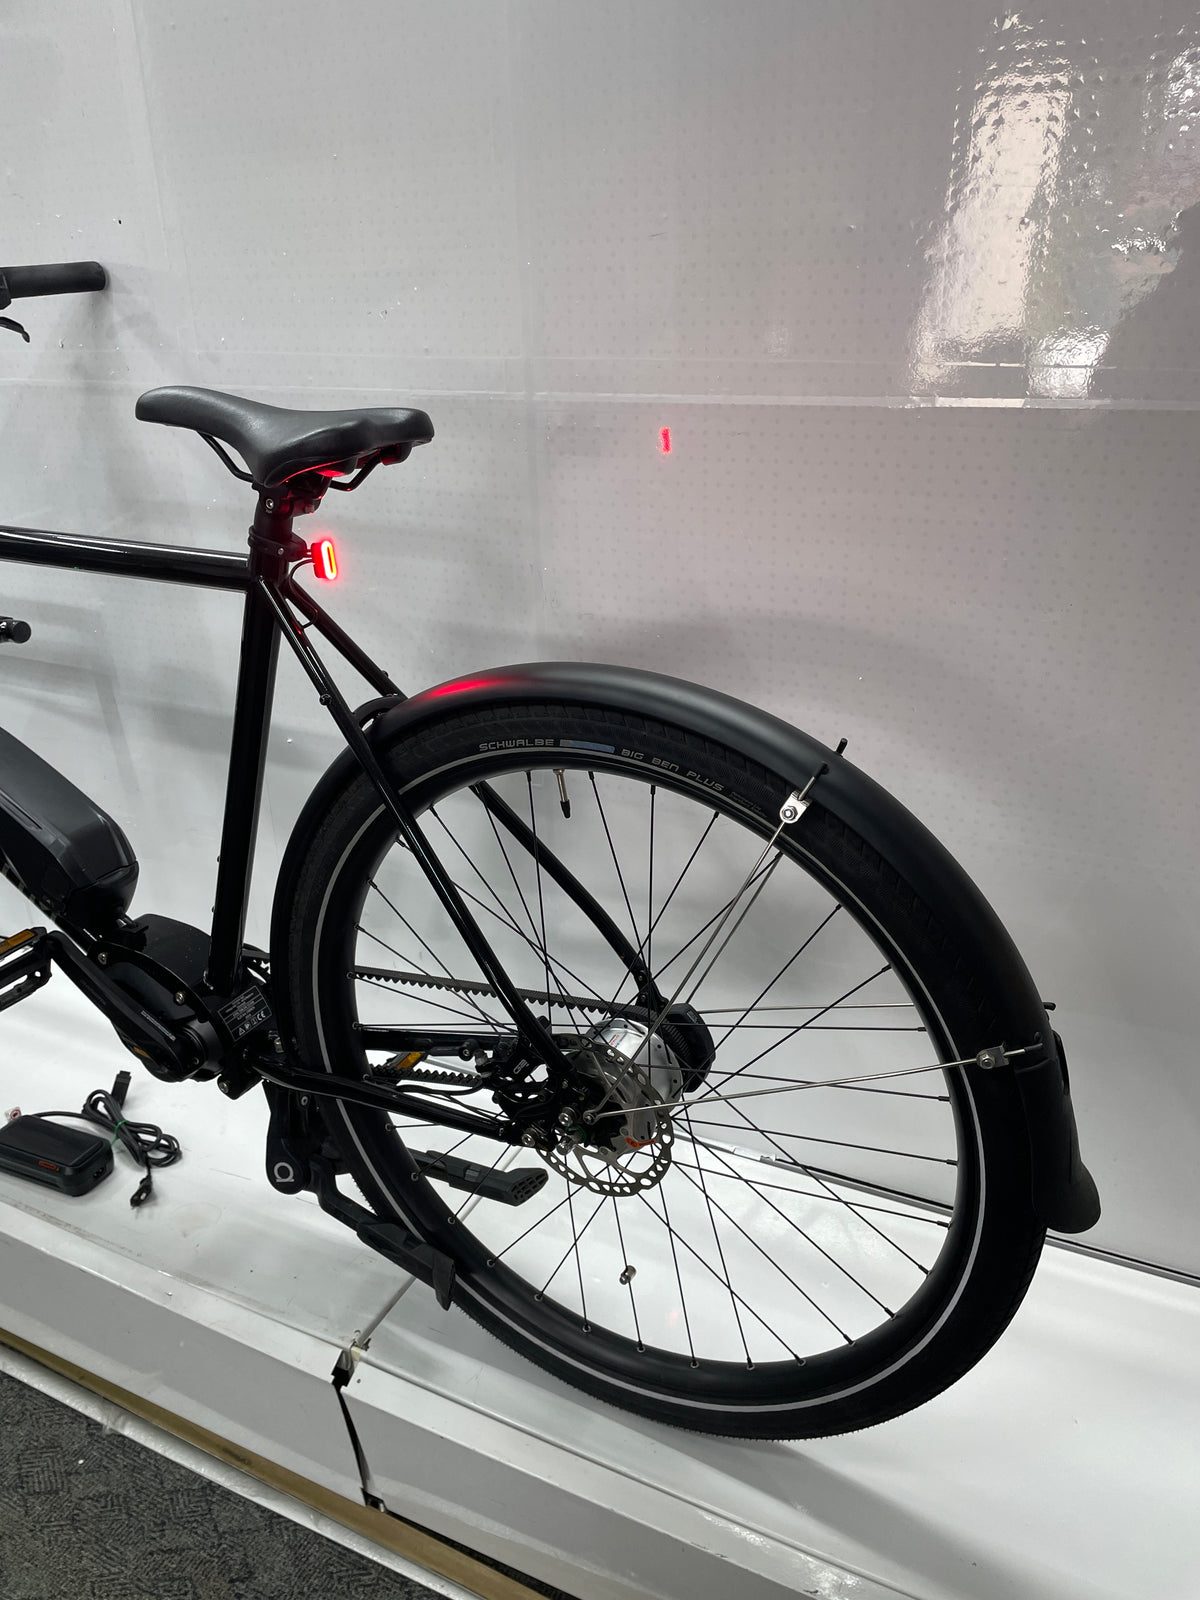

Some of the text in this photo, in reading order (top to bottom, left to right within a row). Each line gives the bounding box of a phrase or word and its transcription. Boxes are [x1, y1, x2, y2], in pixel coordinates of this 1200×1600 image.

[479, 738, 724, 792] SCHWALBE BIG BEN PLUS
